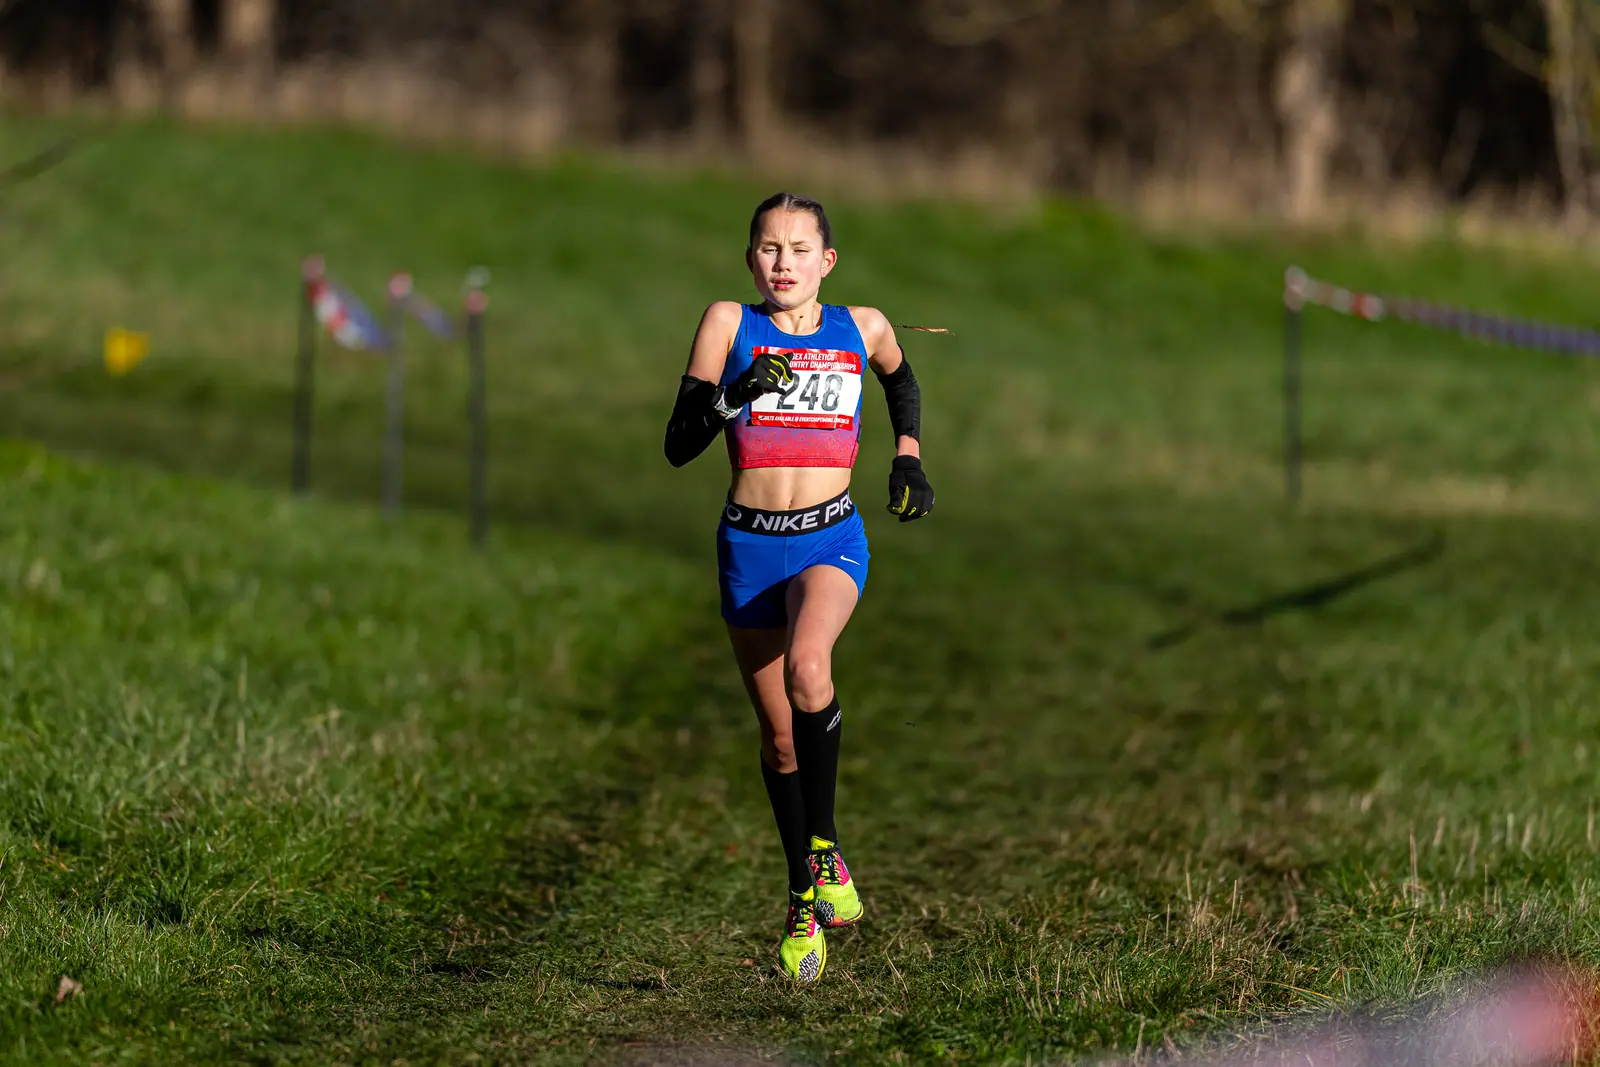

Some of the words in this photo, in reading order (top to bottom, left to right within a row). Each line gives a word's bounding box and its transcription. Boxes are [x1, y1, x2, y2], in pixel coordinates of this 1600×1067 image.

[810, 361, 856, 371] CHAMPIONSHIPS
[777, 373, 843, 412] 248
[751, 509, 820, 532] NIKE
[824, 493, 853, 523] PR
